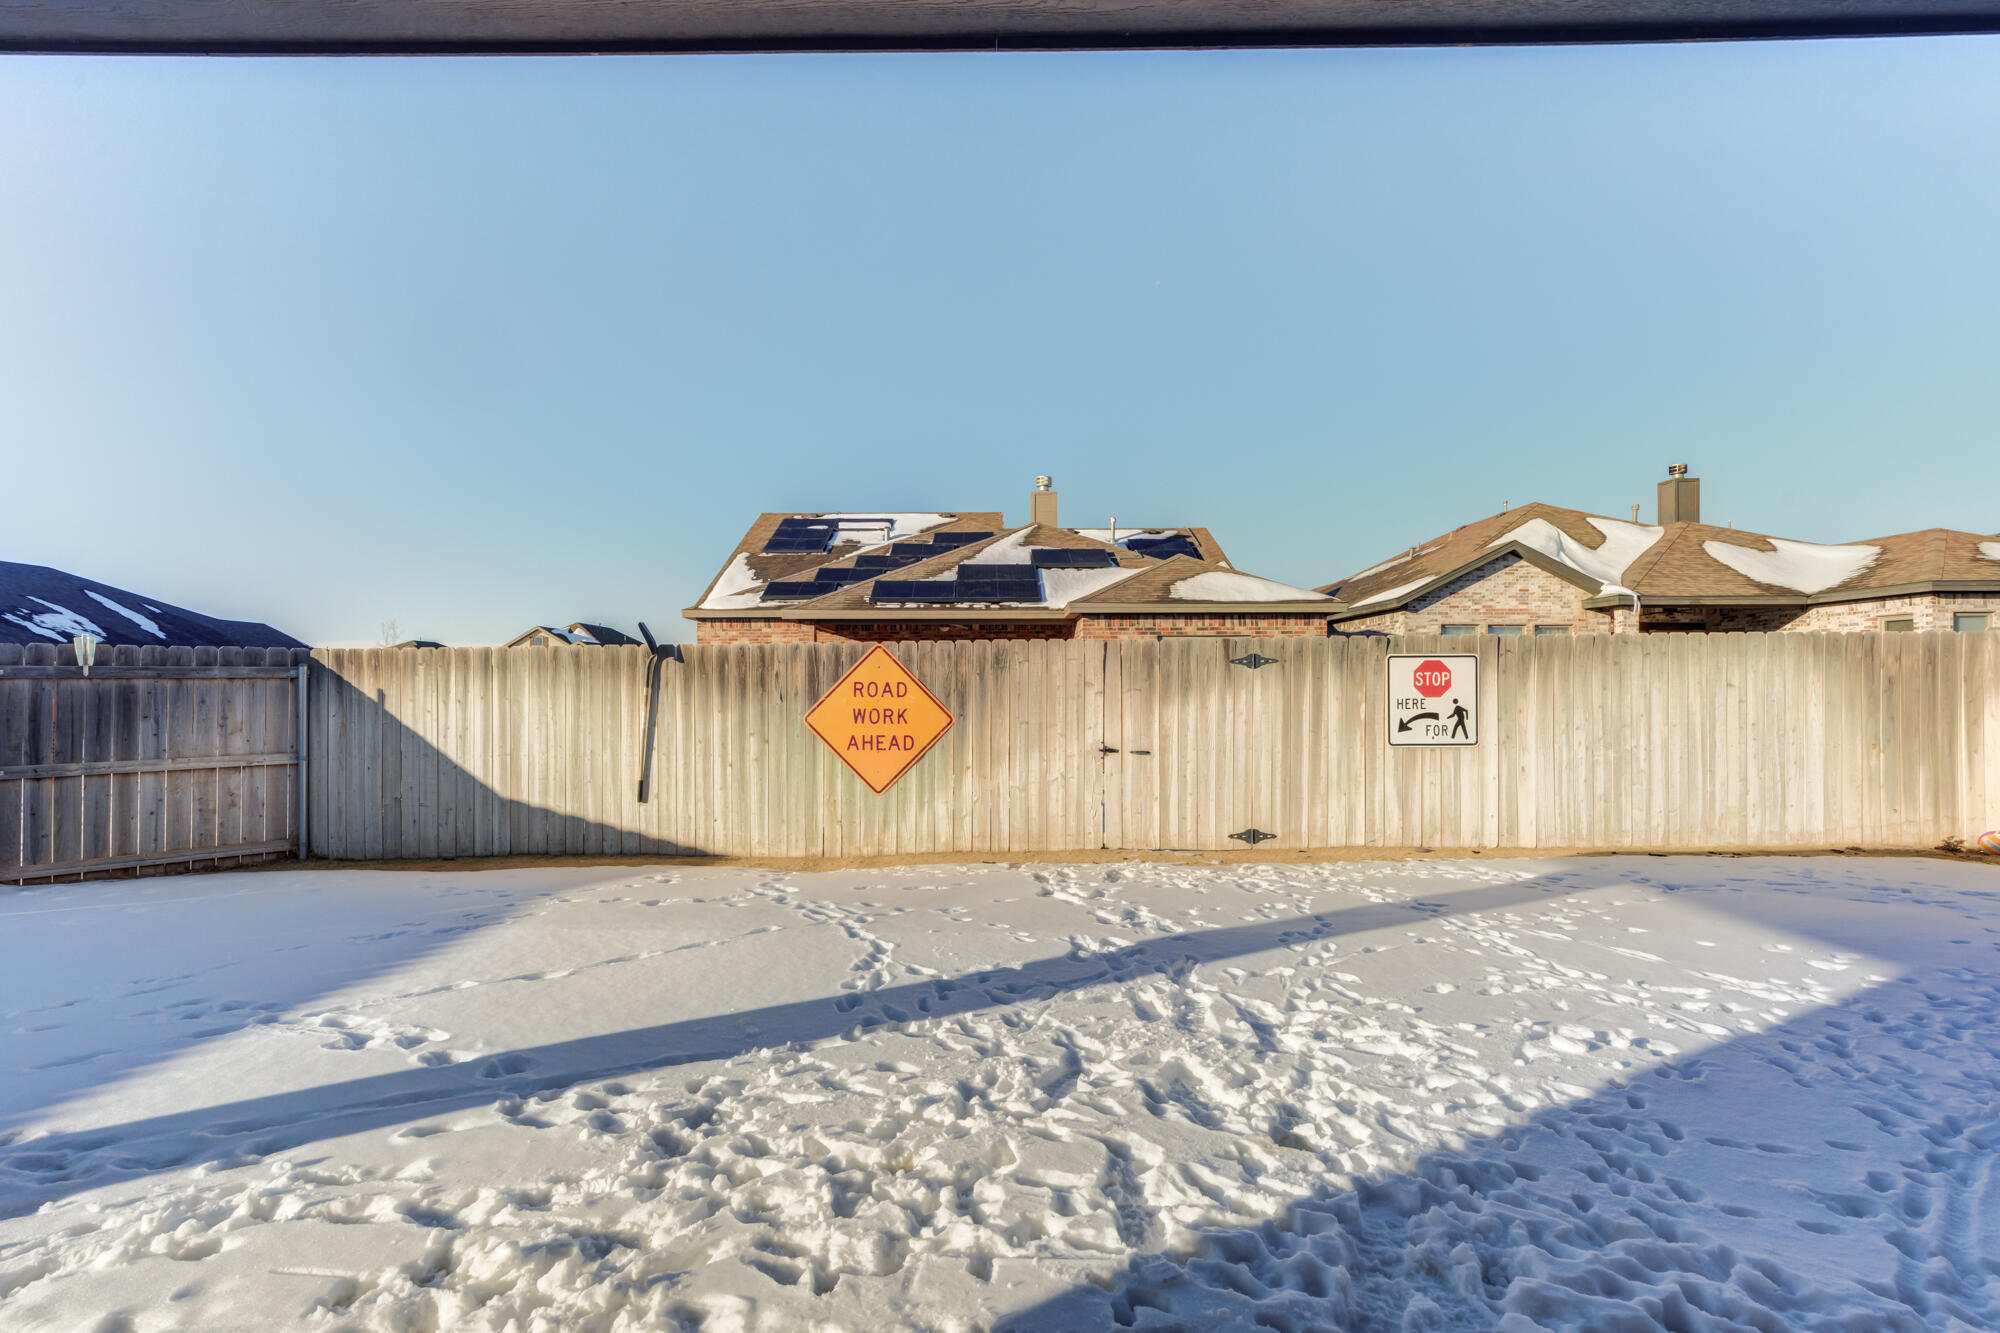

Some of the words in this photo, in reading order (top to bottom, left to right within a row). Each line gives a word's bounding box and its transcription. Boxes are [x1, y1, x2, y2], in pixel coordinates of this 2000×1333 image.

[1415, 671, 1450, 687] STOP
[853, 681, 908, 698] ROAD
[1396, 698, 1427, 710] HERE
[852, 708, 908, 724] WORK
[1425, 724, 1449, 737] FOR
[846, 734, 915, 751] AHEAD
